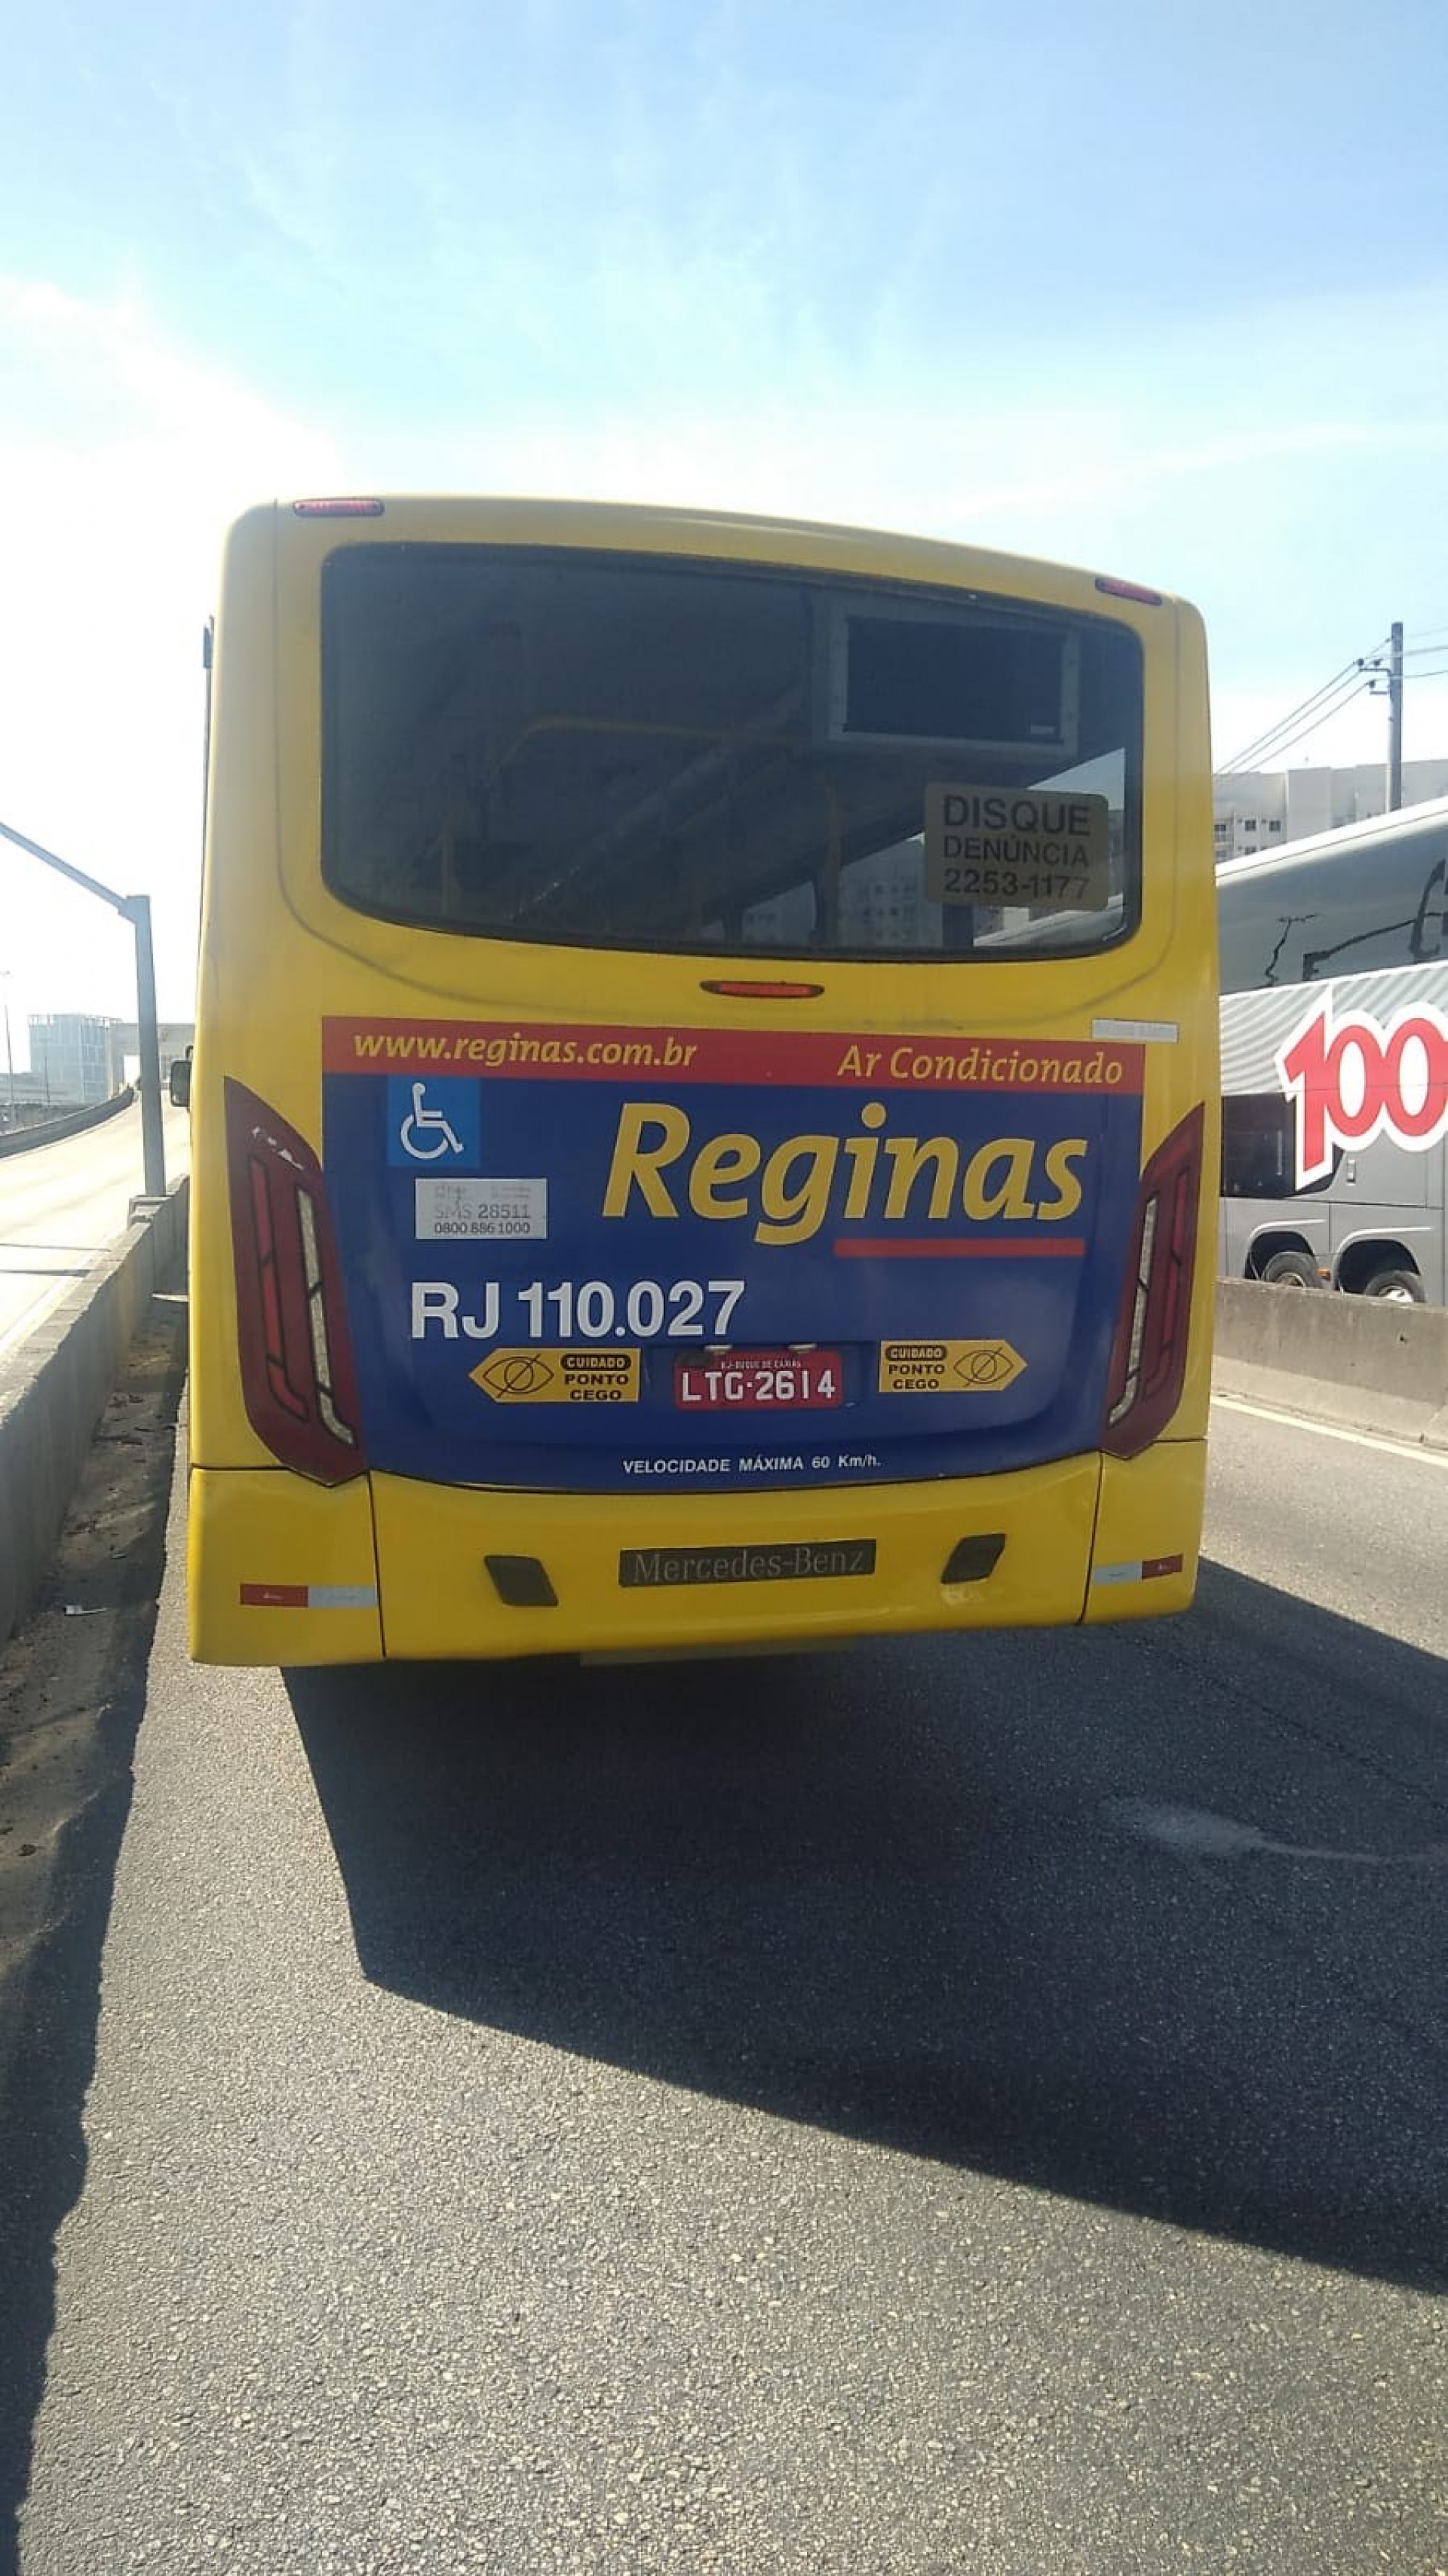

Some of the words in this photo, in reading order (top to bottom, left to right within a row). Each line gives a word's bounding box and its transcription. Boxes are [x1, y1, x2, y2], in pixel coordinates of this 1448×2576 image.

[943, 795, 1091, 836] DISQUE
[943, 833, 1088, 866] DENÚNCIA
[944, 868, 1092, 900] 2253-1177
[354, 1032, 698, 1067] www.reginas.com.br
[837, 1045, 881, 1077] Ar
[890, 1047, 1123, 1084] Condicionado
[1284, 1010, 1448, 1172] 100
[603, 1102, 1088, 1246] Reginas
[412, 1281, 499, 1339] RJ
[517, 1280, 745, 1338] 110.027
[566, 1358, 625, 1369] CUIDADO
[888, 1364, 945, 1375] PONTO
[890, 1348, 942, 1359] CUIDADO
[564, 1373, 629, 1386] PONTO
[569, 1389, 621, 1400] CEGO
[893, 1379, 940, 1390] CEGO
[623, 1458, 731, 1474] VELOCIDADE
[739, 1454, 803, 1471] MÁXIMA
[811, 1455, 830, 1468] 60
[839, 1453, 882, 1467] Km/h.
[634, 1546, 865, 1583] Mercedes-Benz
